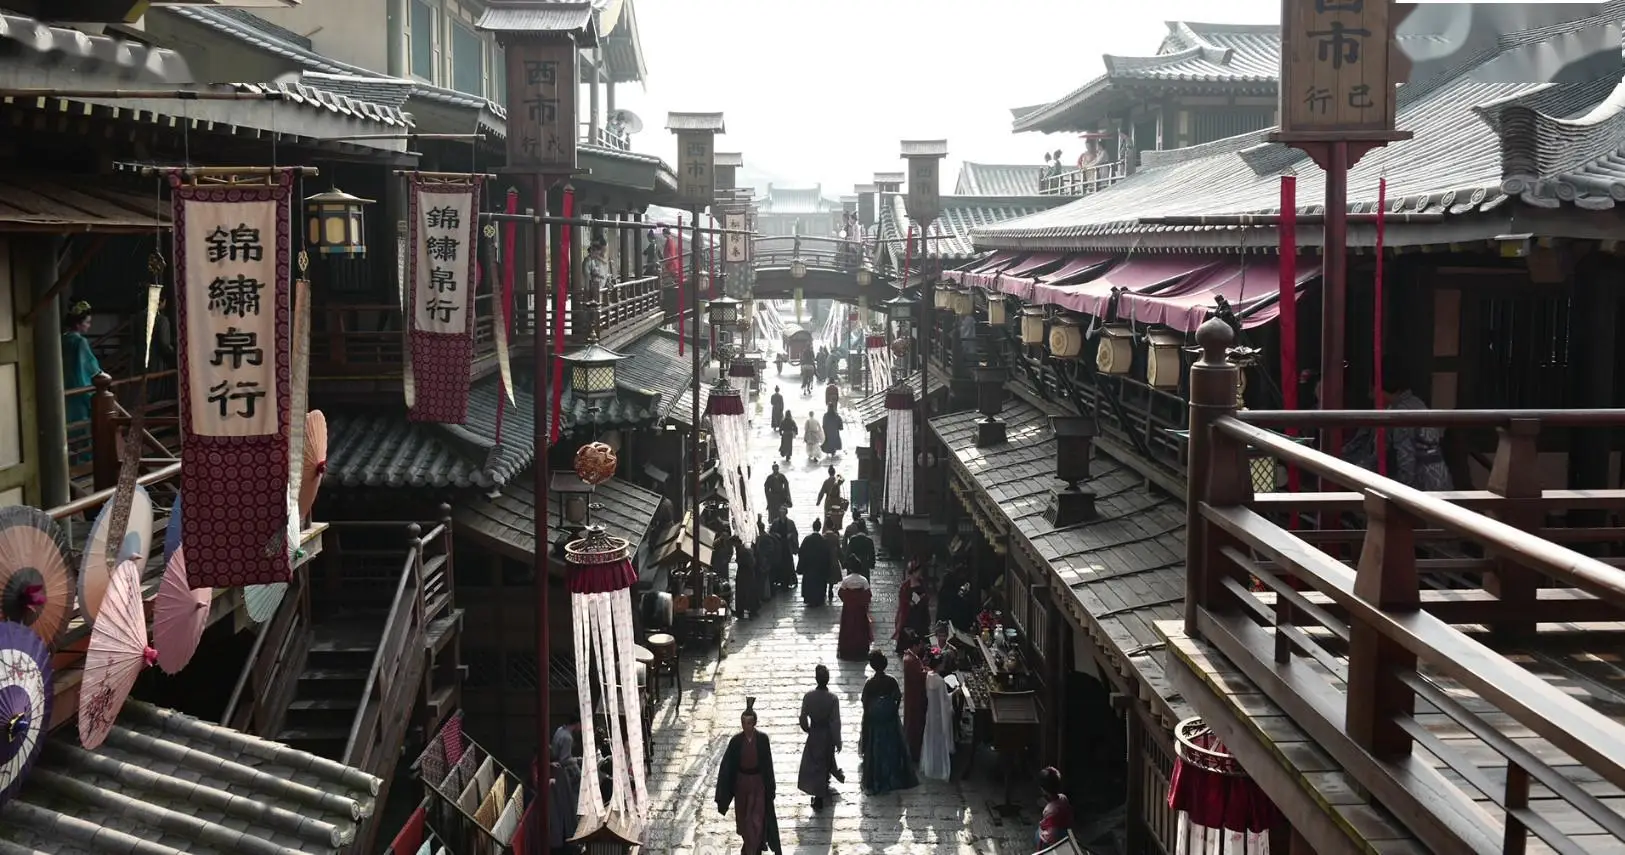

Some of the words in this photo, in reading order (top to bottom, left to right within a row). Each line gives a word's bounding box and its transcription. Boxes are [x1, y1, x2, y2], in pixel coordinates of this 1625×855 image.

[523, 60, 560, 126] 西市
[685, 142, 708, 179] 西市
[425, 205, 460, 324] 錦繡帛行
[205, 223, 266, 419] 錦繡帛行
